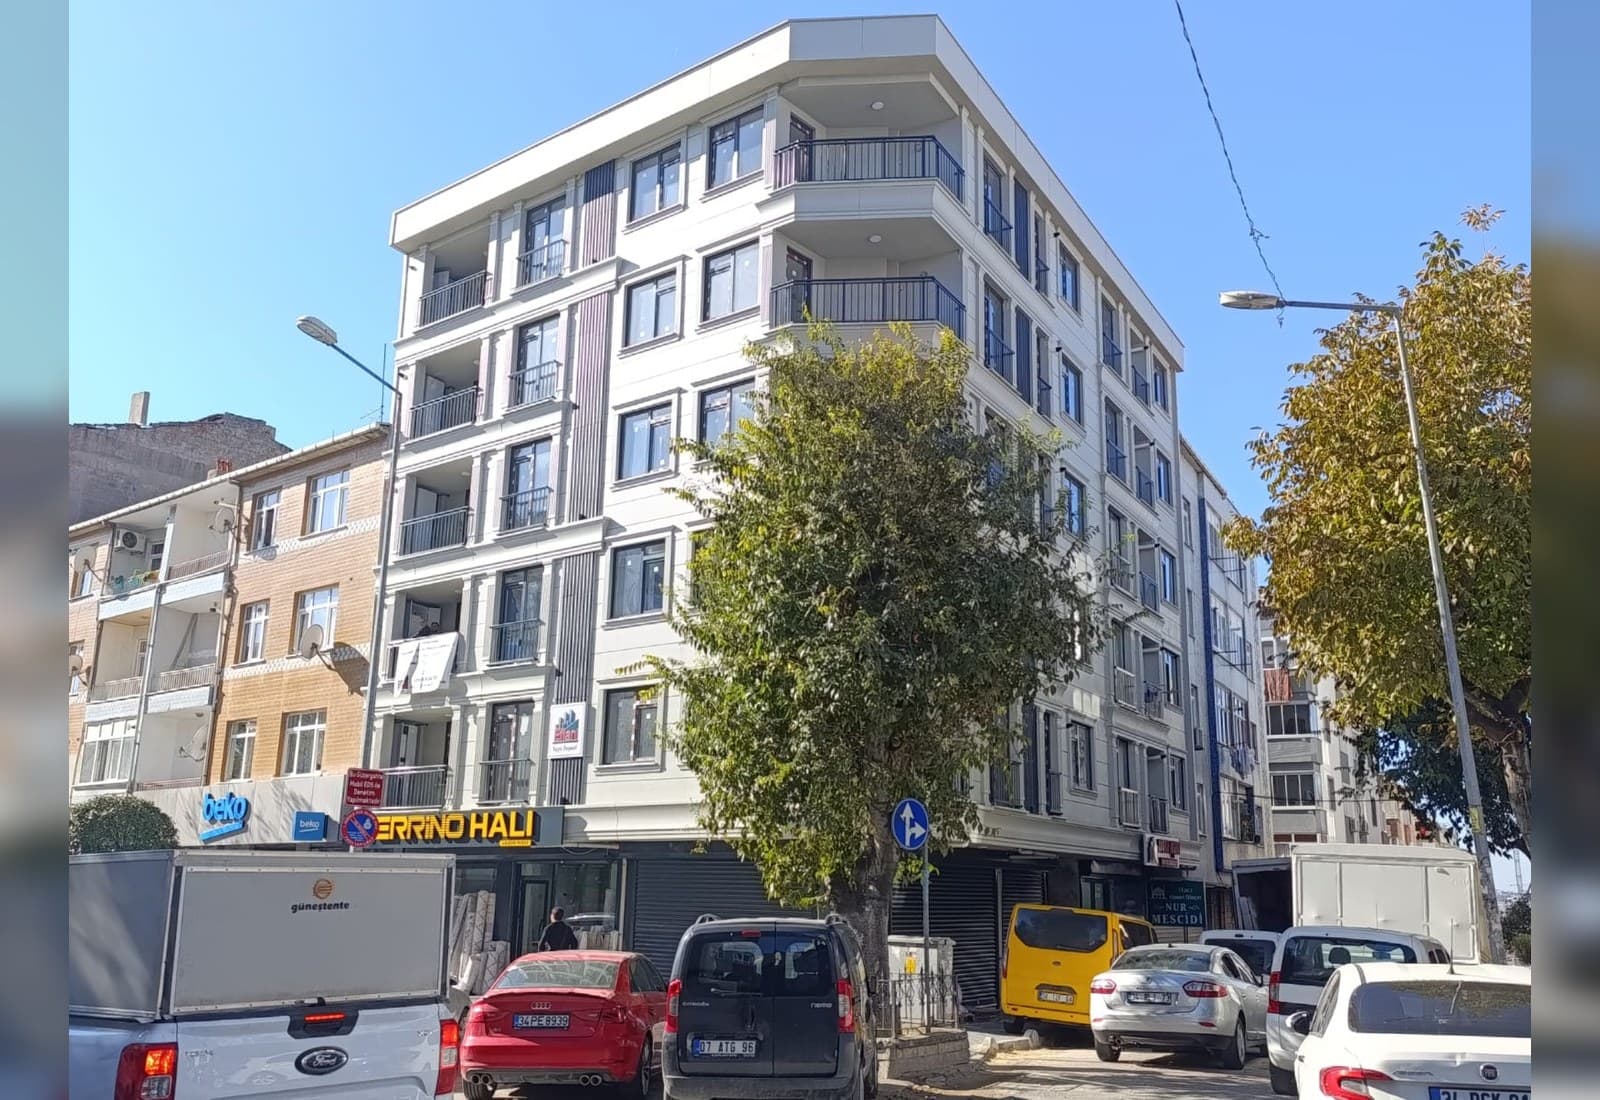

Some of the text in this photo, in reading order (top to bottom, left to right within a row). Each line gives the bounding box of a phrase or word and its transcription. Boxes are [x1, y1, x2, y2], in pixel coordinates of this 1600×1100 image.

[202, 792, 248, 821] beko
[300, 819, 320, 830] beko
[291, 901, 350, 914] güneştente
[1165, 903, 1188, 912] NUR
[519, 1015, 529, 1026] 34
[531, 1015, 544, 1026] PE
[718, 1041, 736, 1052] ATG
[742, 1041, 754, 1052] 96
[312, 1054, 338, 1067] Ford
